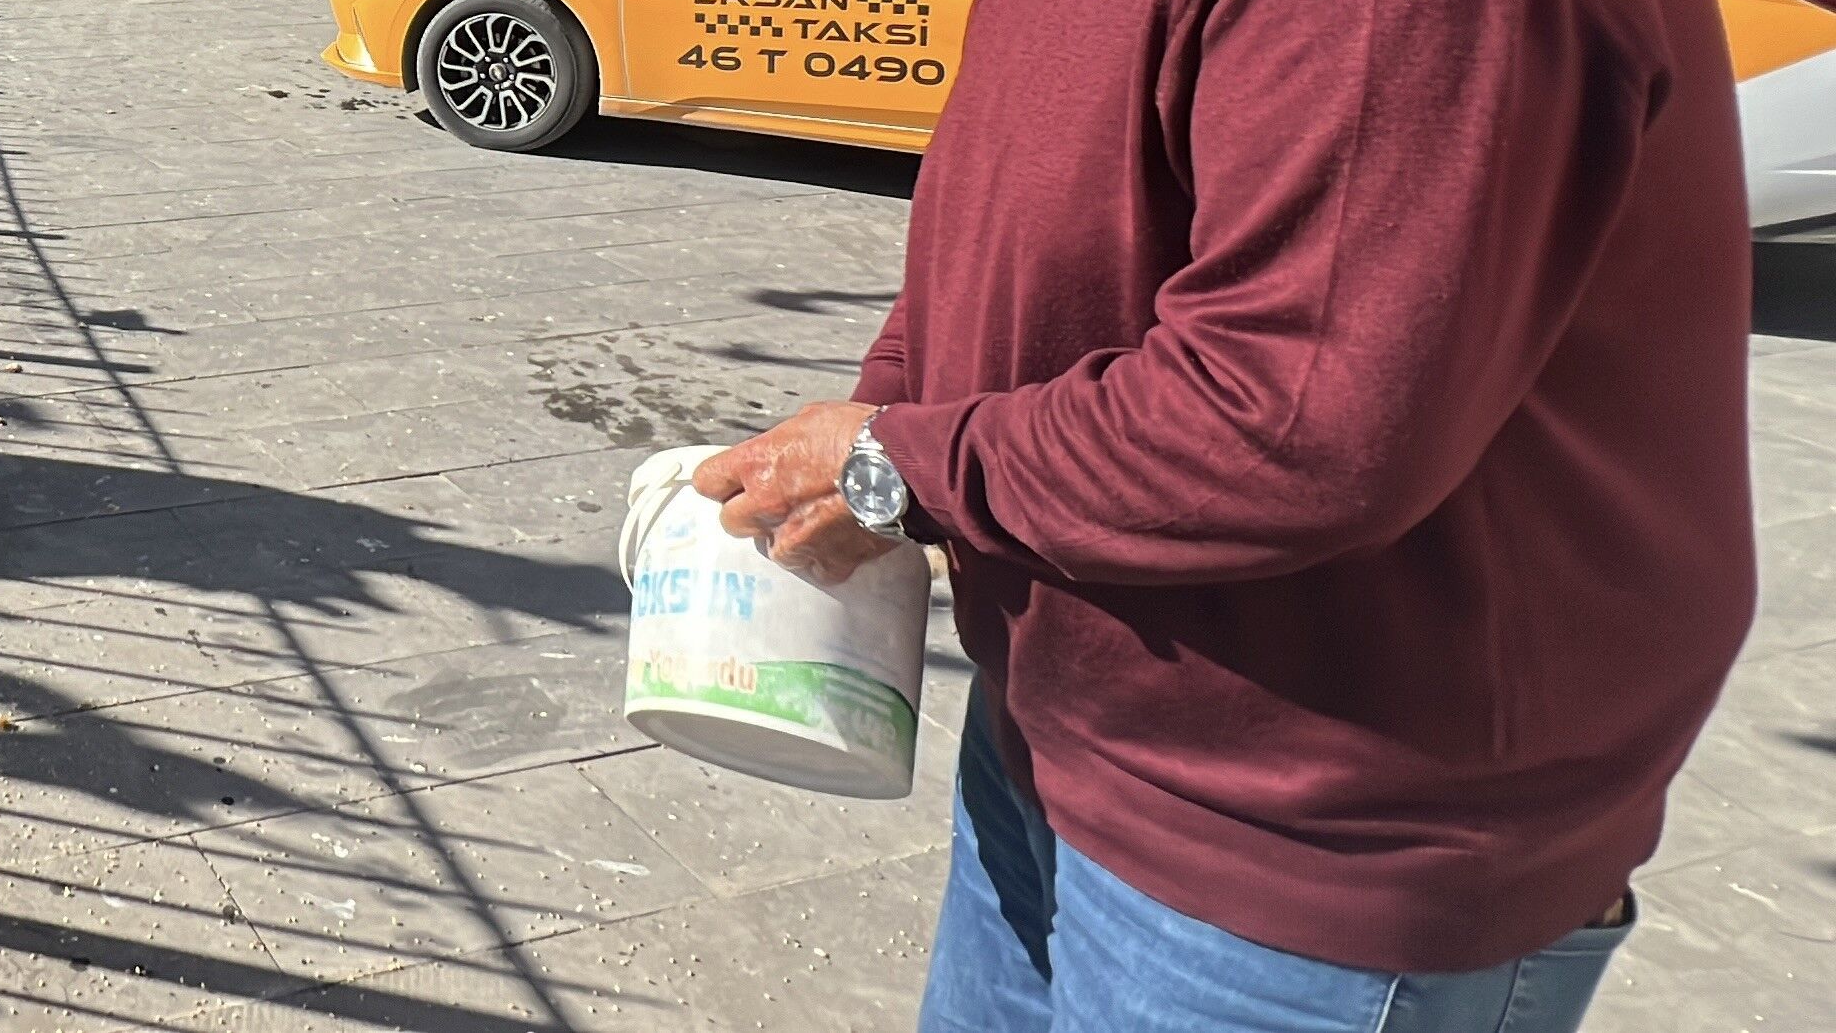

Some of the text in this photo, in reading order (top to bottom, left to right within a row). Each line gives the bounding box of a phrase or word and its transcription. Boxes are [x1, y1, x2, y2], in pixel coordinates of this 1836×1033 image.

[791, 18, 928, 46] TAKSİ
[677, 44, 946, 86] 46 T 0490
